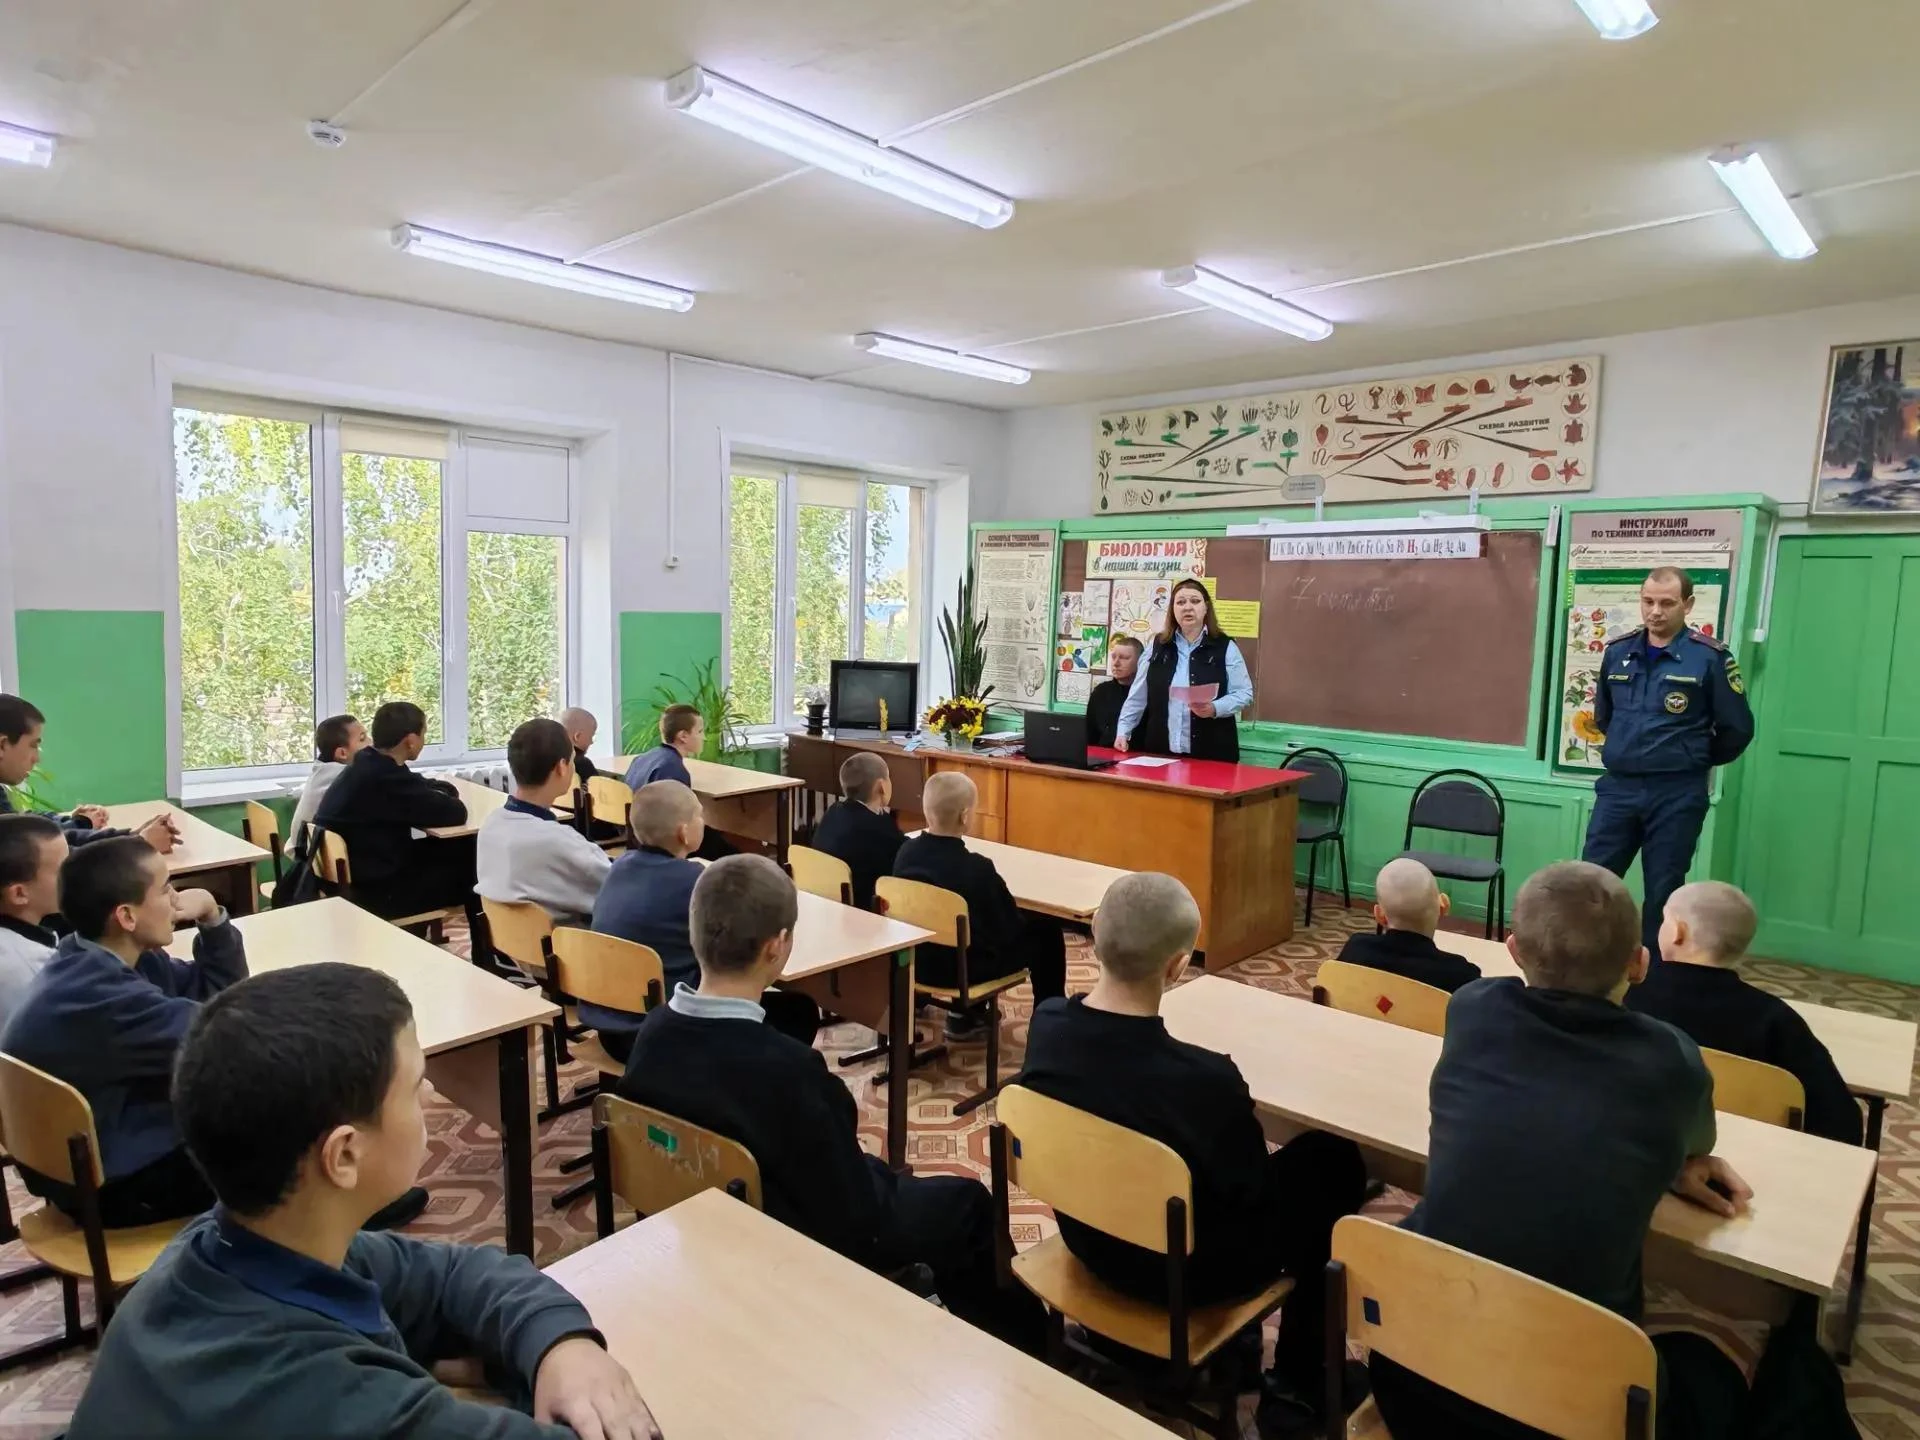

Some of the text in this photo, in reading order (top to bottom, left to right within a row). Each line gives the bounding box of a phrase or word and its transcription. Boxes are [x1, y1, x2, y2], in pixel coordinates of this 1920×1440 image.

[1619, 518, 1688, 529] ИНСТРУКЦИЯ
[1591, 528, 1716, 538] ПО ТЕХНИКЕ БЕЗОПАСНОСТИ
[1100, 543, 1187, 557] БИОЛОГИЯ
[1104, 559, 1139, 572] нашей
